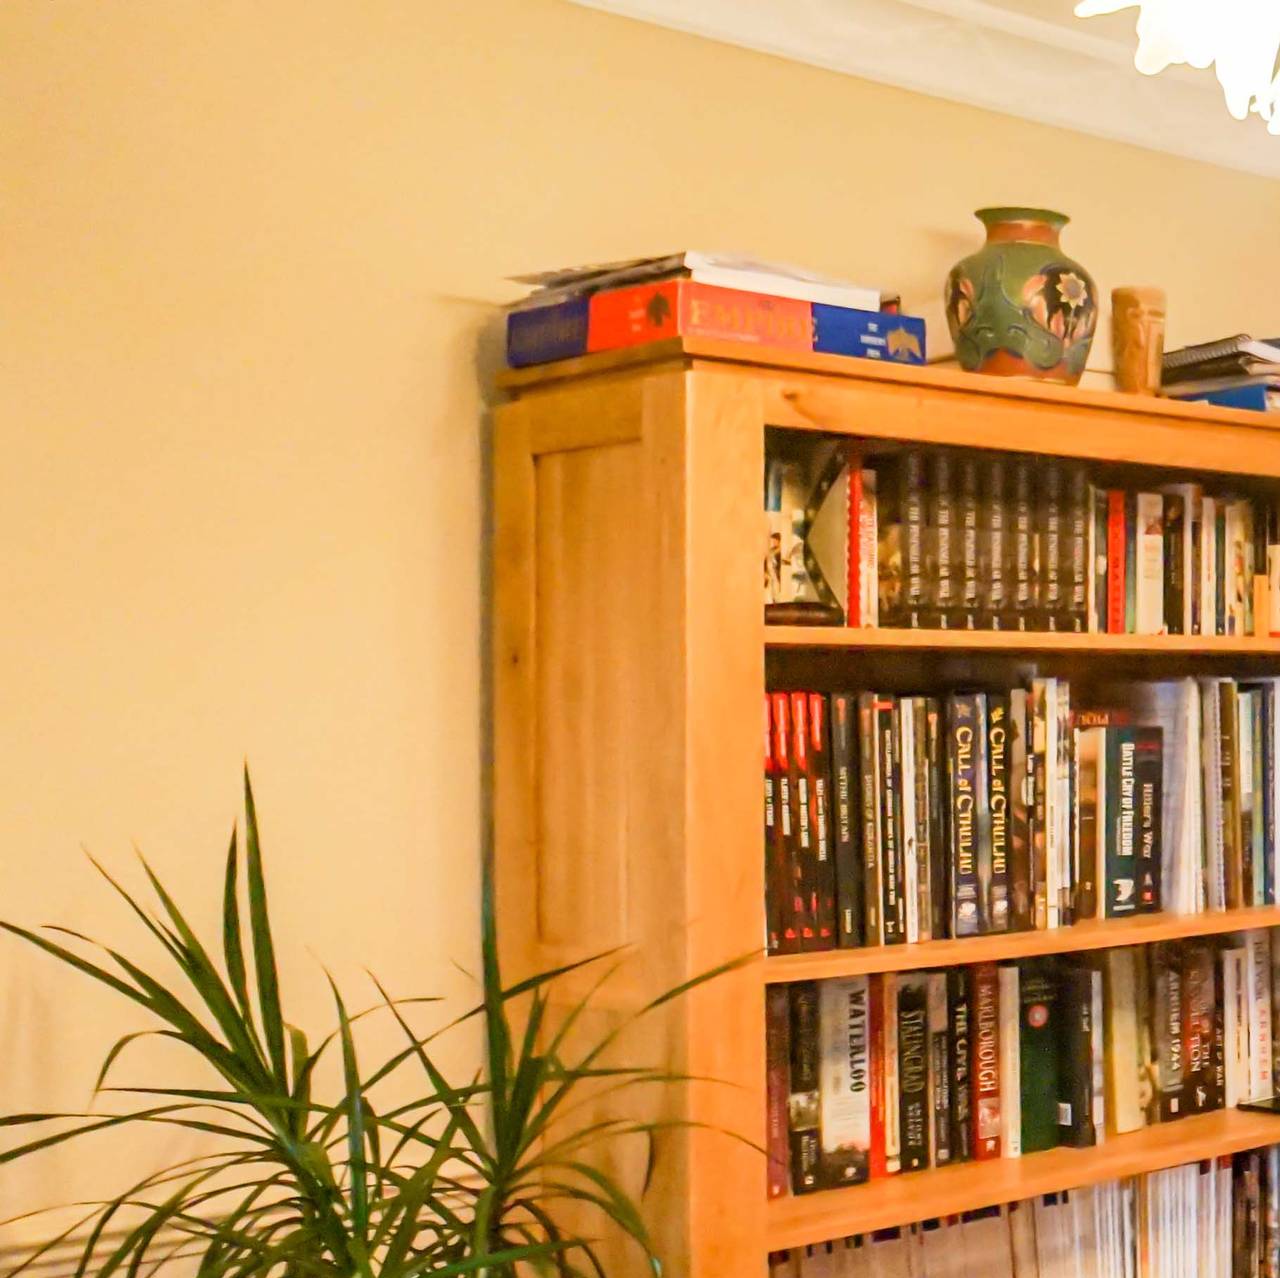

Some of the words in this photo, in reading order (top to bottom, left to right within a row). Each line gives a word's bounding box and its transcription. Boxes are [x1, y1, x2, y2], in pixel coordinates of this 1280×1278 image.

[956, 726, 974, 775] CALL
[990, 727, 1006, 776] CALL
[1121, 743, 1135, 777] BATTLE
[958, 778, 973, 791] of
[991, 779, 1005, 792] of
[956, 794, 974, 875] CTHULHU
[990, 795, 1007, 874] CTHULHU
[1121, 811, 1135, 856] FREEDOM
[1143, 832, 1154, 858] War
[956, 1003, 968, 1035] THE
[1168, 971, 1182, 1034] ARNHEM
[848, 989, 867, 1093] WATERLOO
[900, 1010, 926, 1093] STALINGRAD
[978, 985, 996, 1092] MARLBOROUGH
[1170, 1039, 1182, 1070] 1944
[1215, 1065, 1223, 1086] WAR
